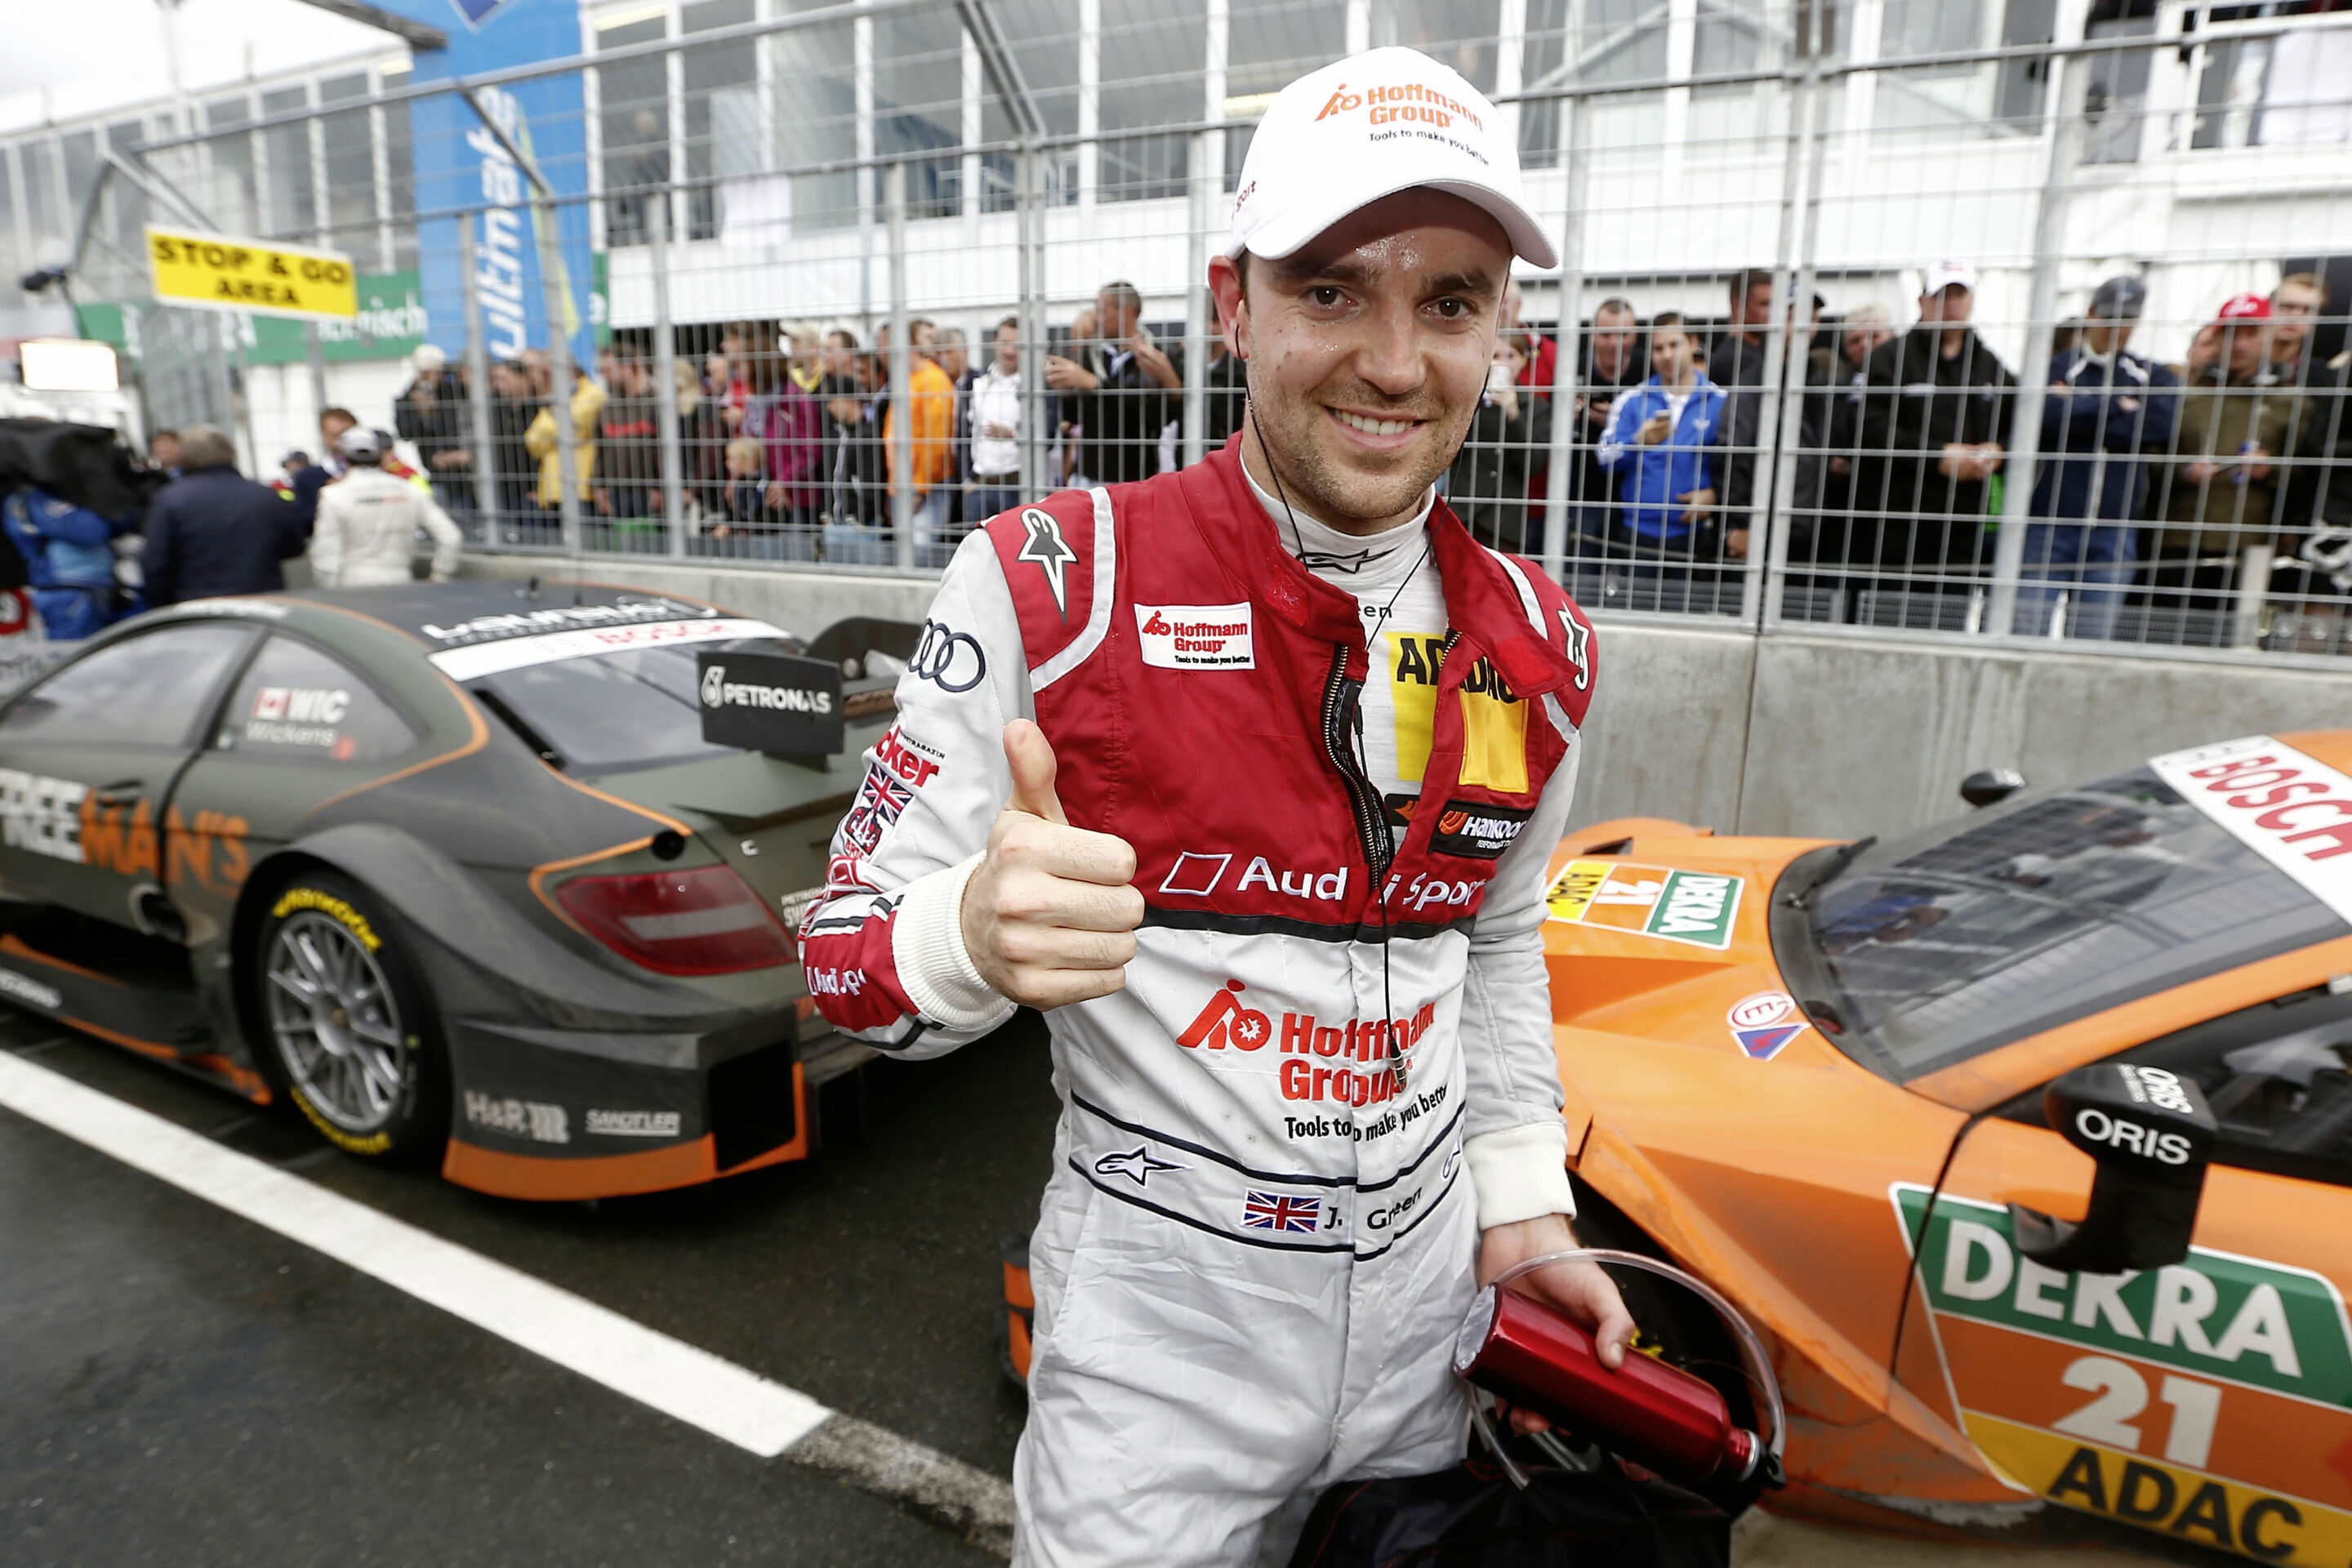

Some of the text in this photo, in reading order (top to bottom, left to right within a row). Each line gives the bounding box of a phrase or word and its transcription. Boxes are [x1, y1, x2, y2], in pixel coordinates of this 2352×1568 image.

[1368, 84, 1483, 132] Hoffmann
[1370, 106, 1451, 128] Group
[1370, 130, 1397, 141] Tools
[1401, 129, 1412, 138] to
[1416, 131, 1446, 143] make
[1448, 138, 1465, 151] you
[466, 84, 528, 361] ultimate
[154, 240, 349, 284] STOP & GO
[214, 280, 302, 305] AREA
[1174, 622, 1248, 637] Hoffmann
[1174, 638, 1223, 653] Group
[1219, 657, 1231, 666] you
[288, 688, 351, 724] WIC
[724, 682, 832, 714] PETRONAS
[872, 724, 940, 788] cker
[1594, 880, 1663, 905] 21
[1658, 875, 1731, 933] DEKRA
[1285, 1116, 1330, 1139] Tools
[1366, 1113, 1397, 1142] make
[1401, 1105, 1420, 1131] you
[2075, 1109, 2192, 1165] ORIS
[1324, 1187, 1422, 1230] J. Green
[1940, 1218, 2303, 1379] DEKRA
[2051, 1356, 2223, 1471] 21
[2047, 1447, 2303, 1558] ADAC
